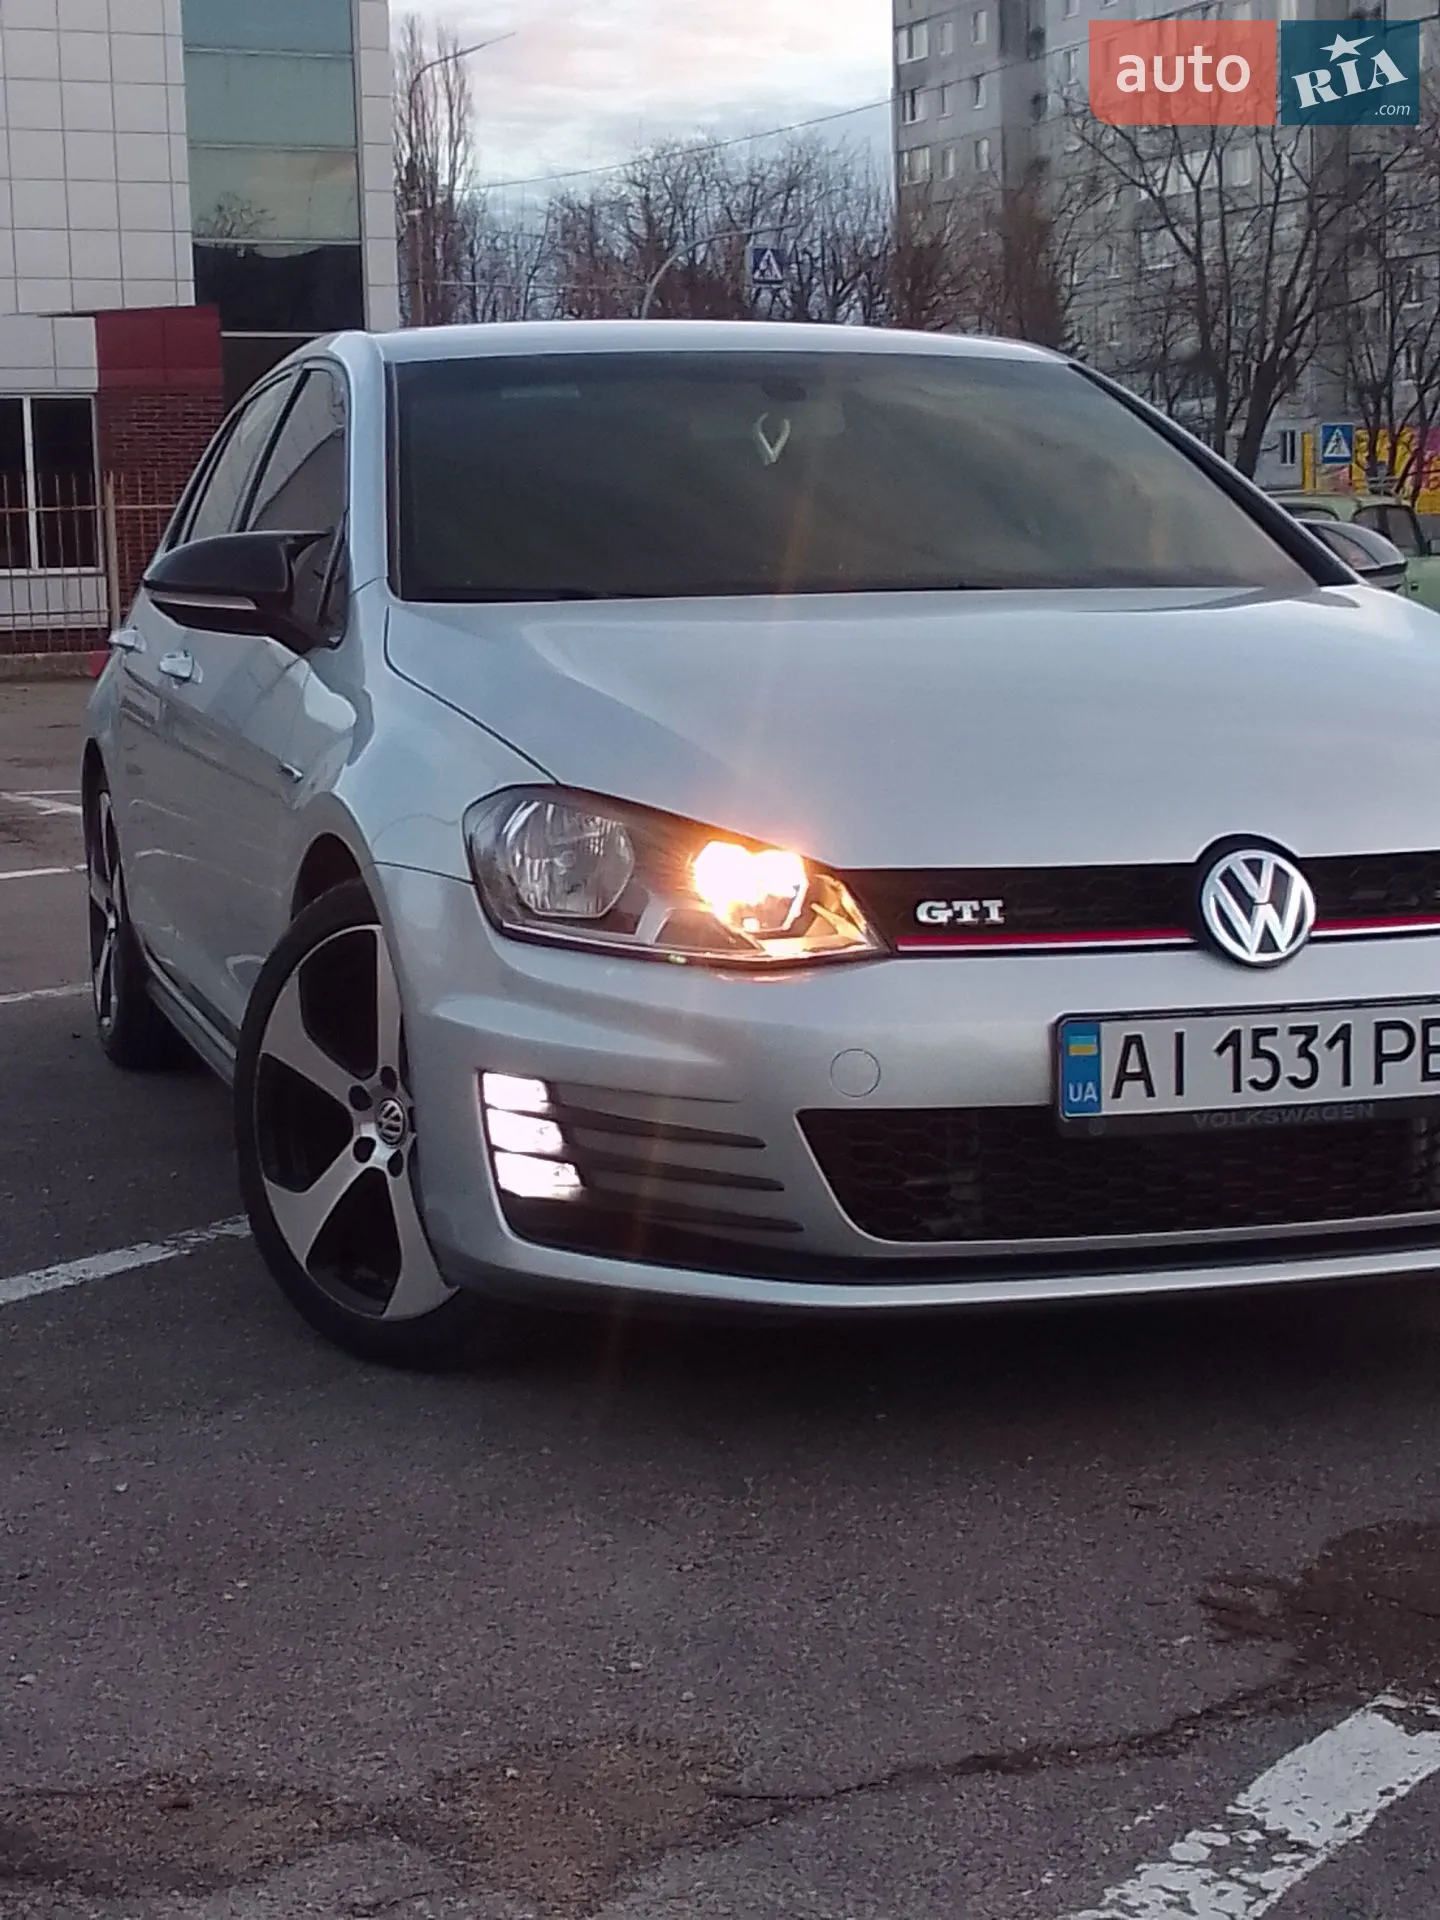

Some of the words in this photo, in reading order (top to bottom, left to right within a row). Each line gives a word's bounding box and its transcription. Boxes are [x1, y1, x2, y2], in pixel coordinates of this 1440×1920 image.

[916, 899, 1005, 925] GTI
[1110, 1030, 1185, 1100] AI
[1212, 1022, 1353, 1094] 1531
[1068, 1083, 1098, 1102] UA
[1191, 1102, 1375, 1129] VOLKSWAGEN
